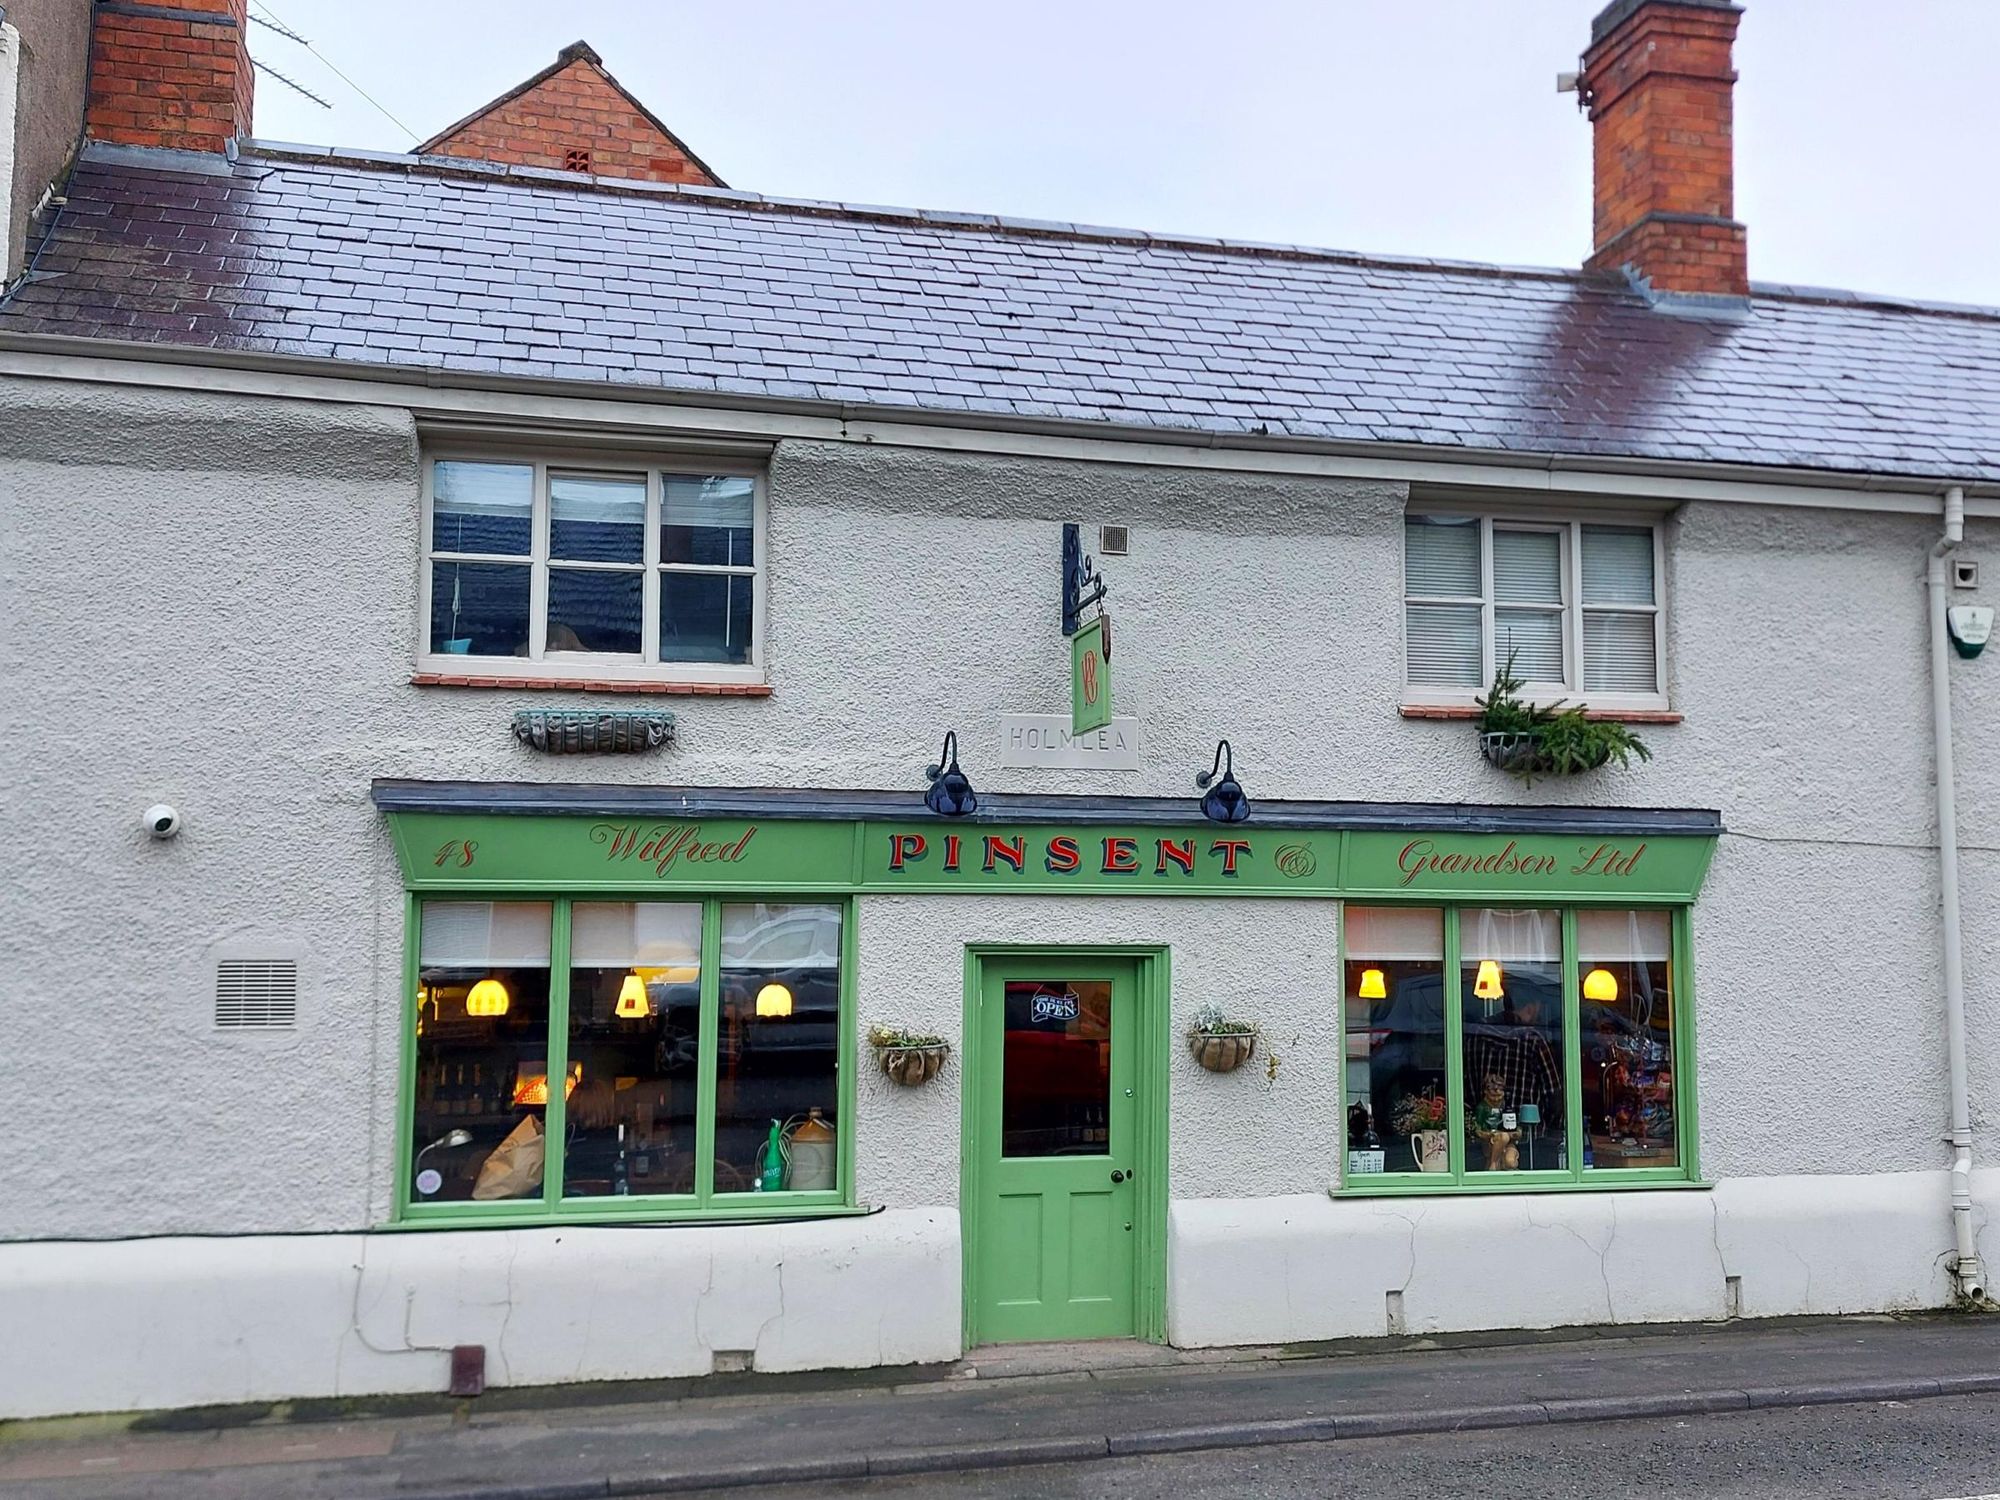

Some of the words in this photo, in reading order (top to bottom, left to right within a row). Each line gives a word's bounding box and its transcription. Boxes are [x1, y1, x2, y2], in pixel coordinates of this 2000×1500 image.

[1010, 727, 1127, 751] HOLMLEA
[434, 839, 480, 868] 48
[589, 824, 758, 878] Wilfred
[888, 833, 1253, 878] PINSENT
[1397, 838, 1557, 887] Grandson
[1571, 842, 1647, 876] Ltd
[1036, 1001, 1075, 1016] OPEN
